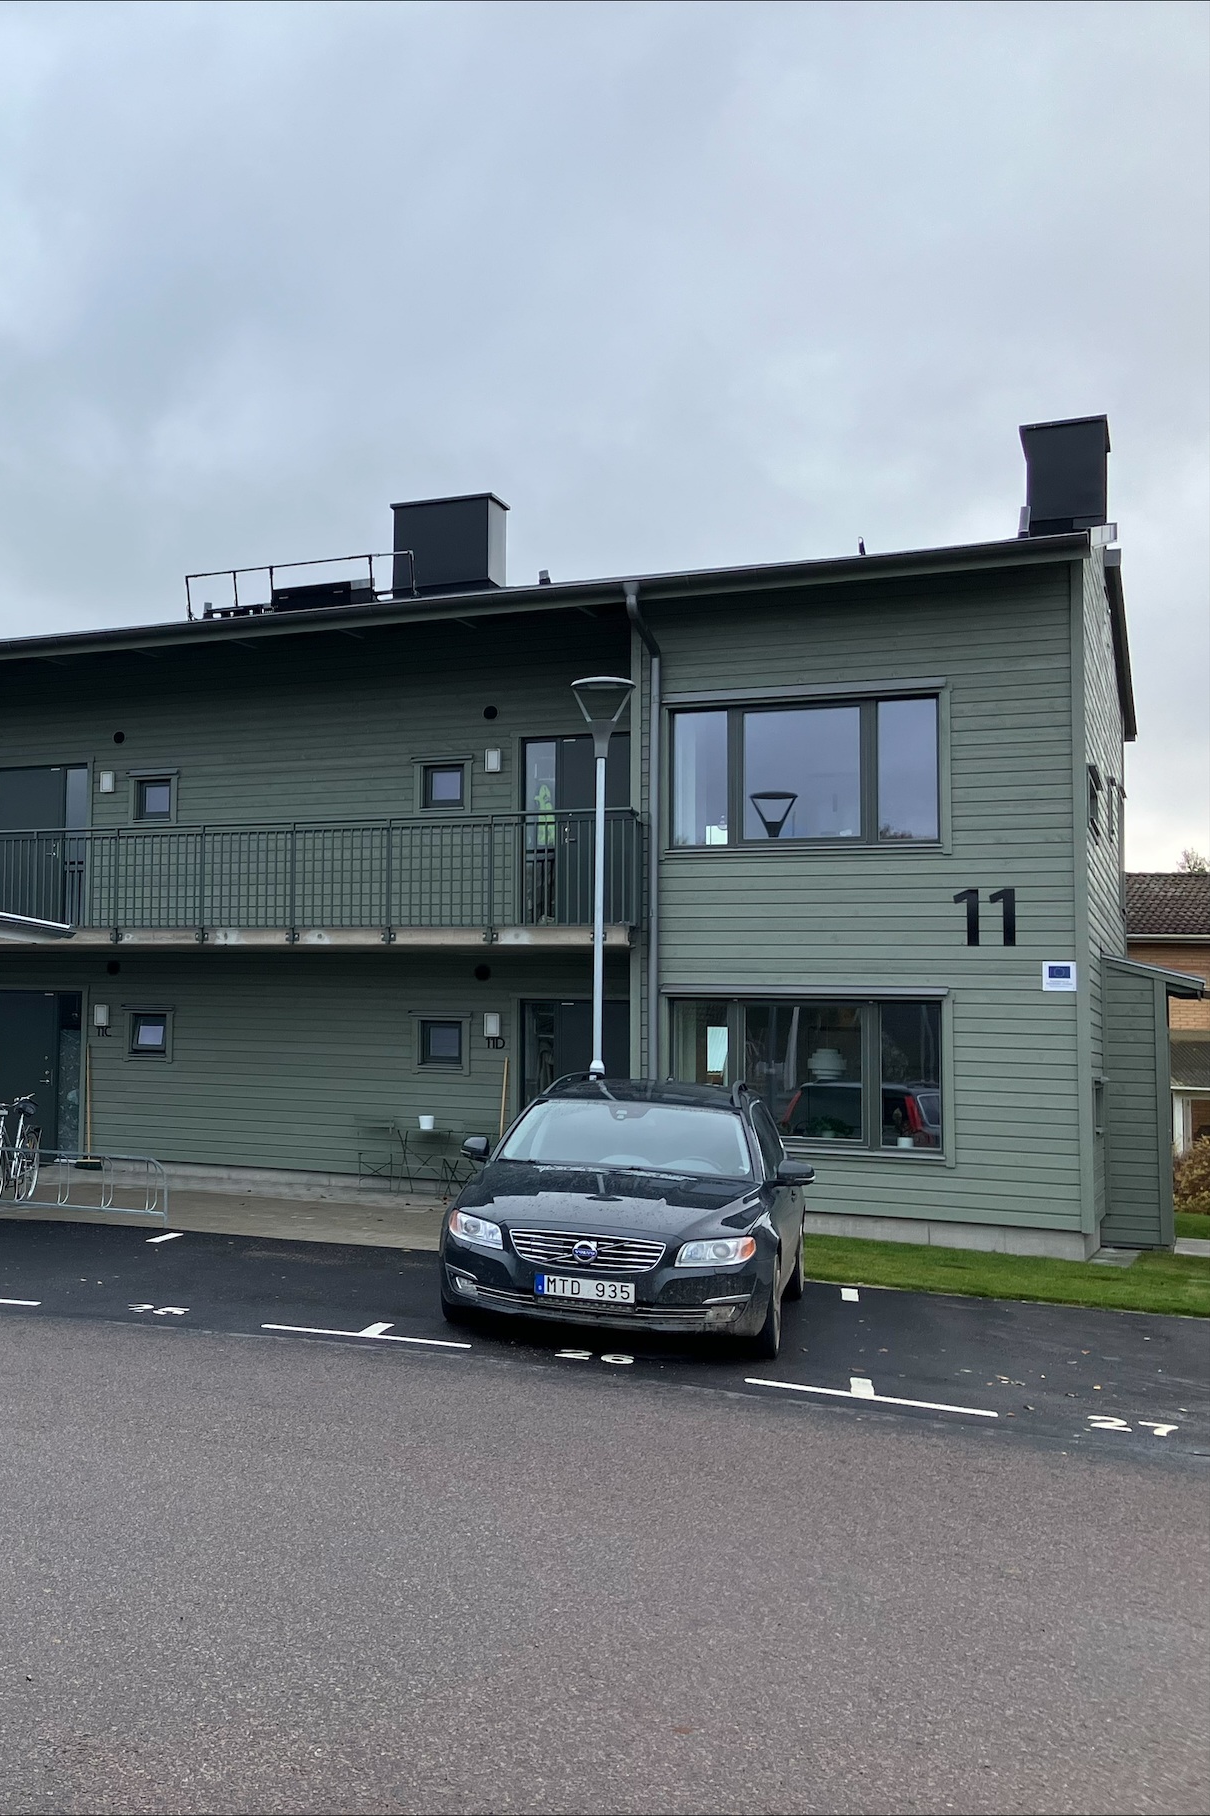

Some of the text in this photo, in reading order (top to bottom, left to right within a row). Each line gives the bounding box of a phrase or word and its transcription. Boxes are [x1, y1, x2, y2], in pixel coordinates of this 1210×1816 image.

[953, 888, 1016, 946] 11
[96, 1026, 111, 1037] 11C
[486, 1037, 505, 1049] 11D
[547, 1276, 630, 1300] MTD 935
[554, 1349, 634, 1364] 26
[1087, 1415, 1179, 1436] 27
